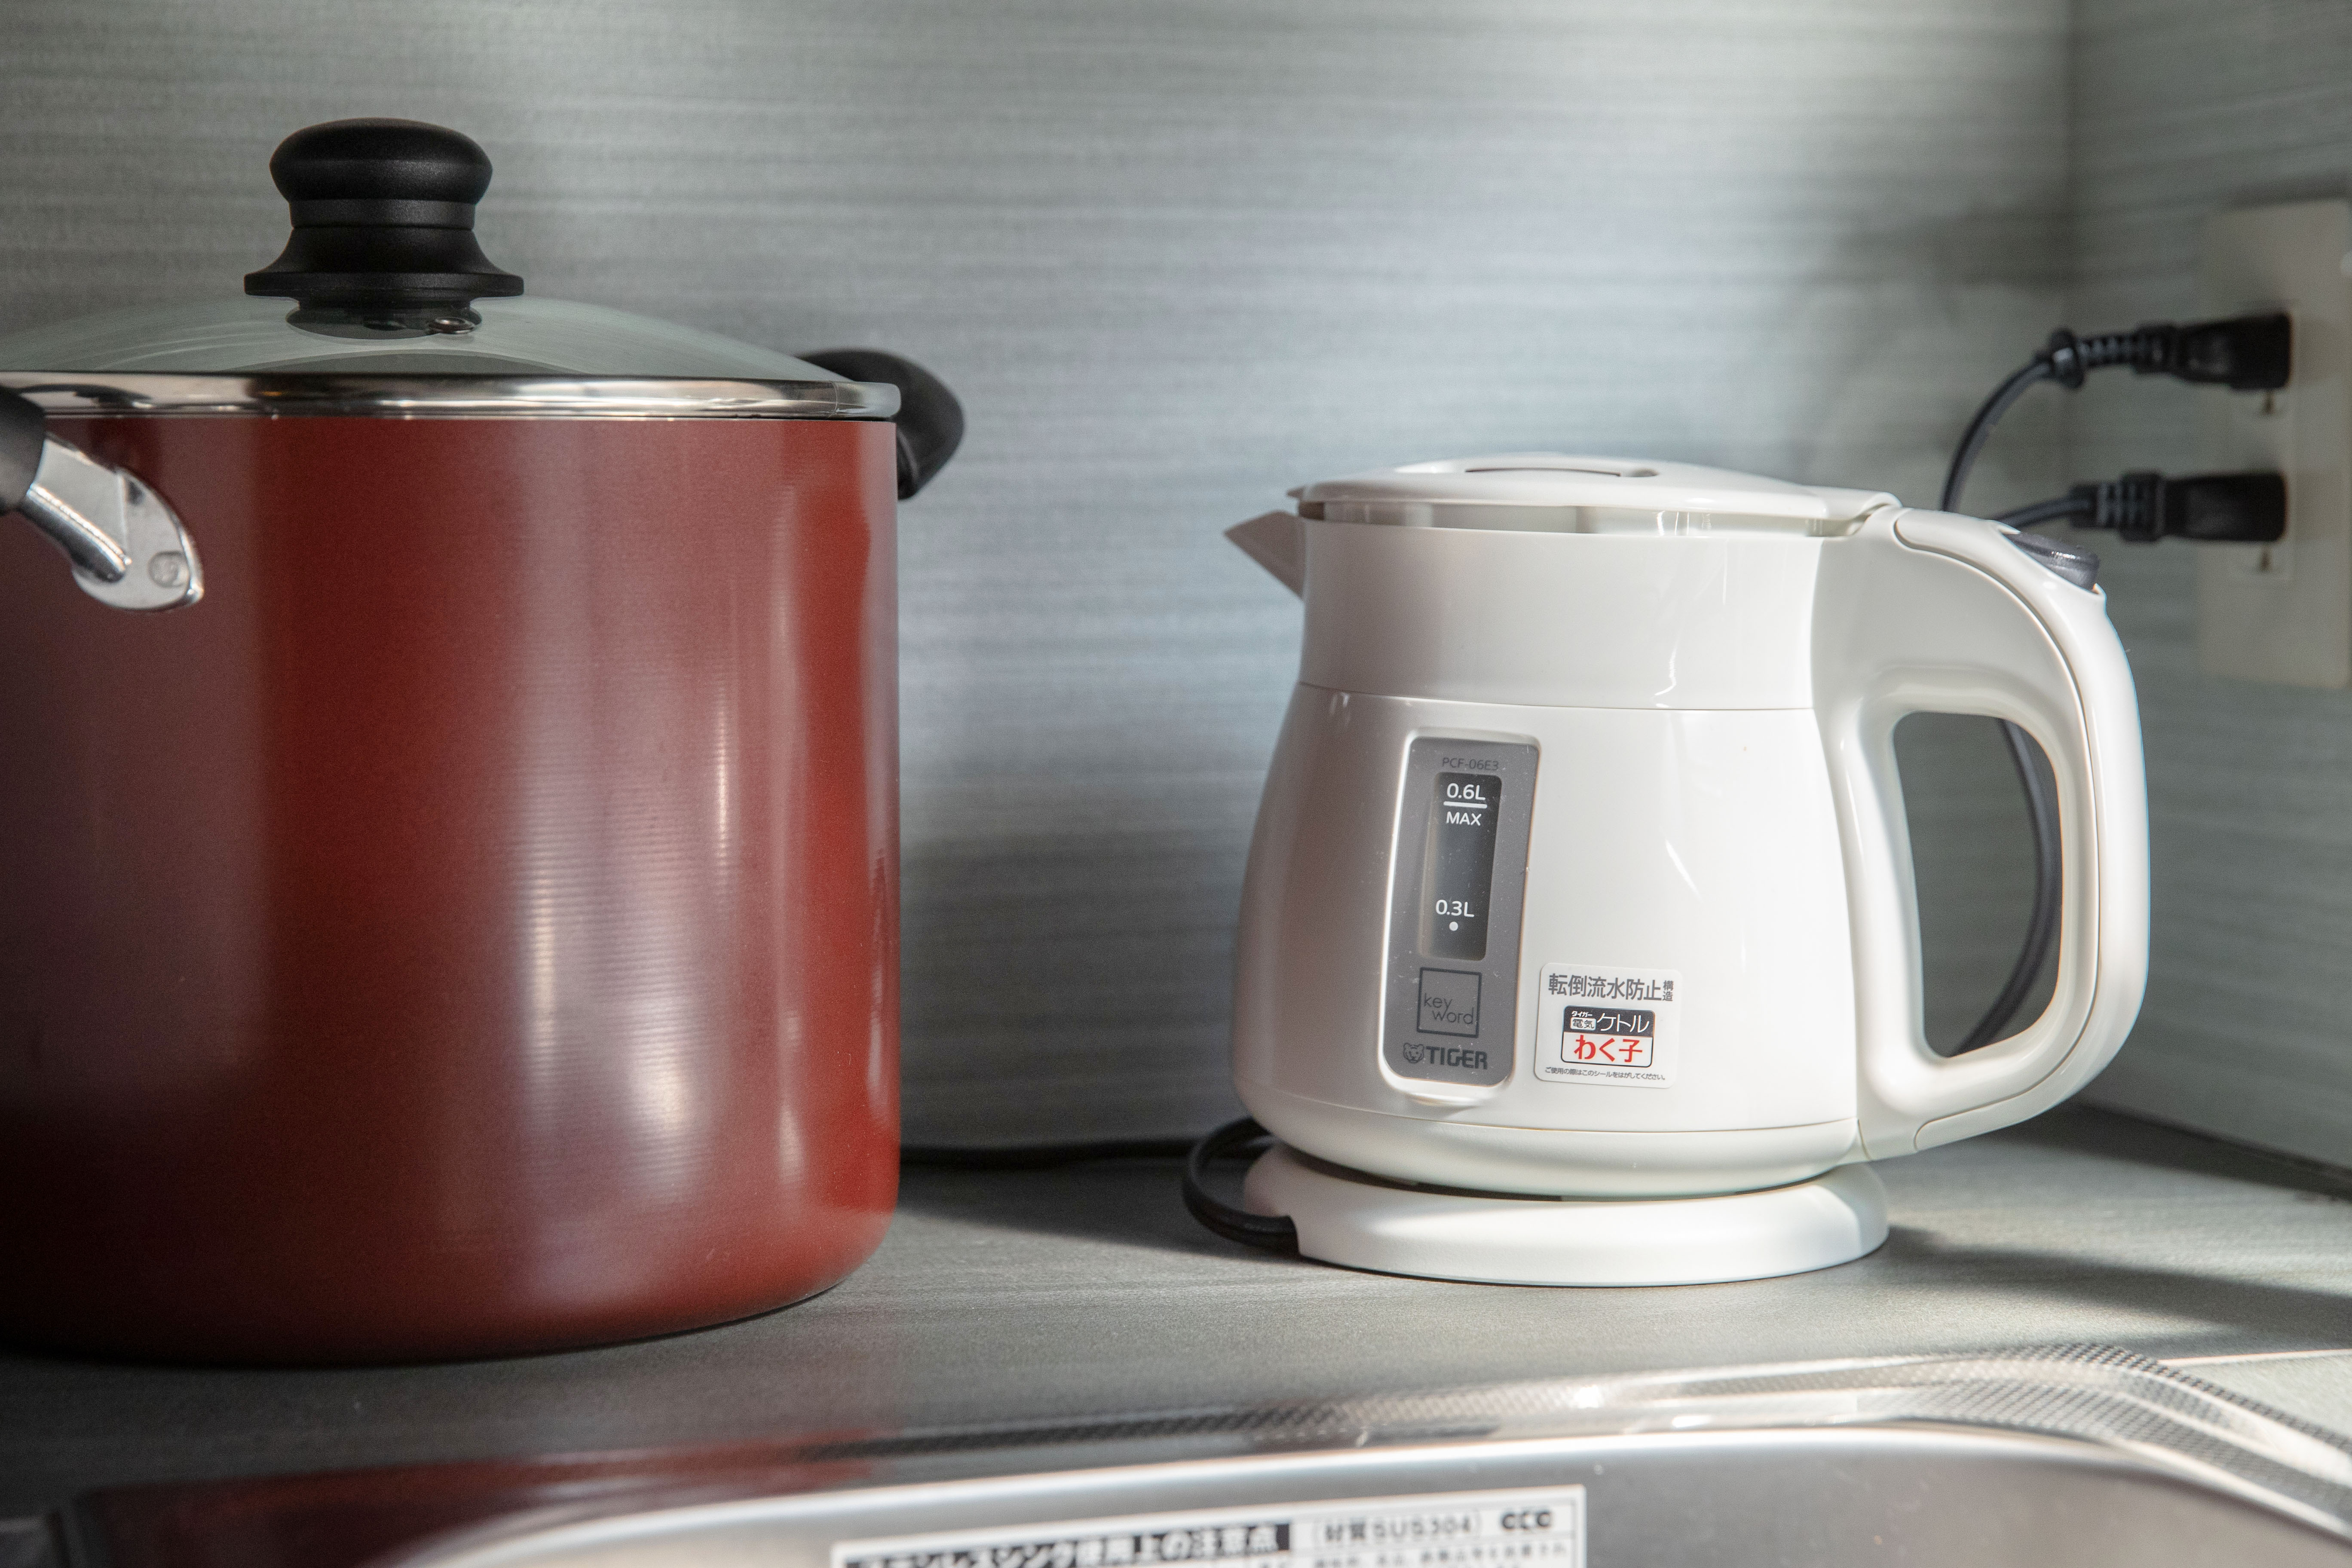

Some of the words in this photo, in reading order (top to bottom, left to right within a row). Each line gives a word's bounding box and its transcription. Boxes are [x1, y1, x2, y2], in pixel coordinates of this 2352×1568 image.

[1442, 757, 1499, 770] PCF-06E3
[1447, 783, 1486, 800] 0.6L
[1446, 811, 1482, 825] MAX
[1436, 899, 1475, 917] 0.3L
[1548, 973, 1662, 1001] 転倒流水防止
[1424, 993, 1453, 1011] key
[1432, 1008, 1475, 1025] word
[1573, 1019, 1594, 1029] 電気
[1597, 1013, 1650, 1033] ケトル
[1574, 1034, 1643, 1063] わく子
[1425, 1046, 1488, 1070] TIGER
